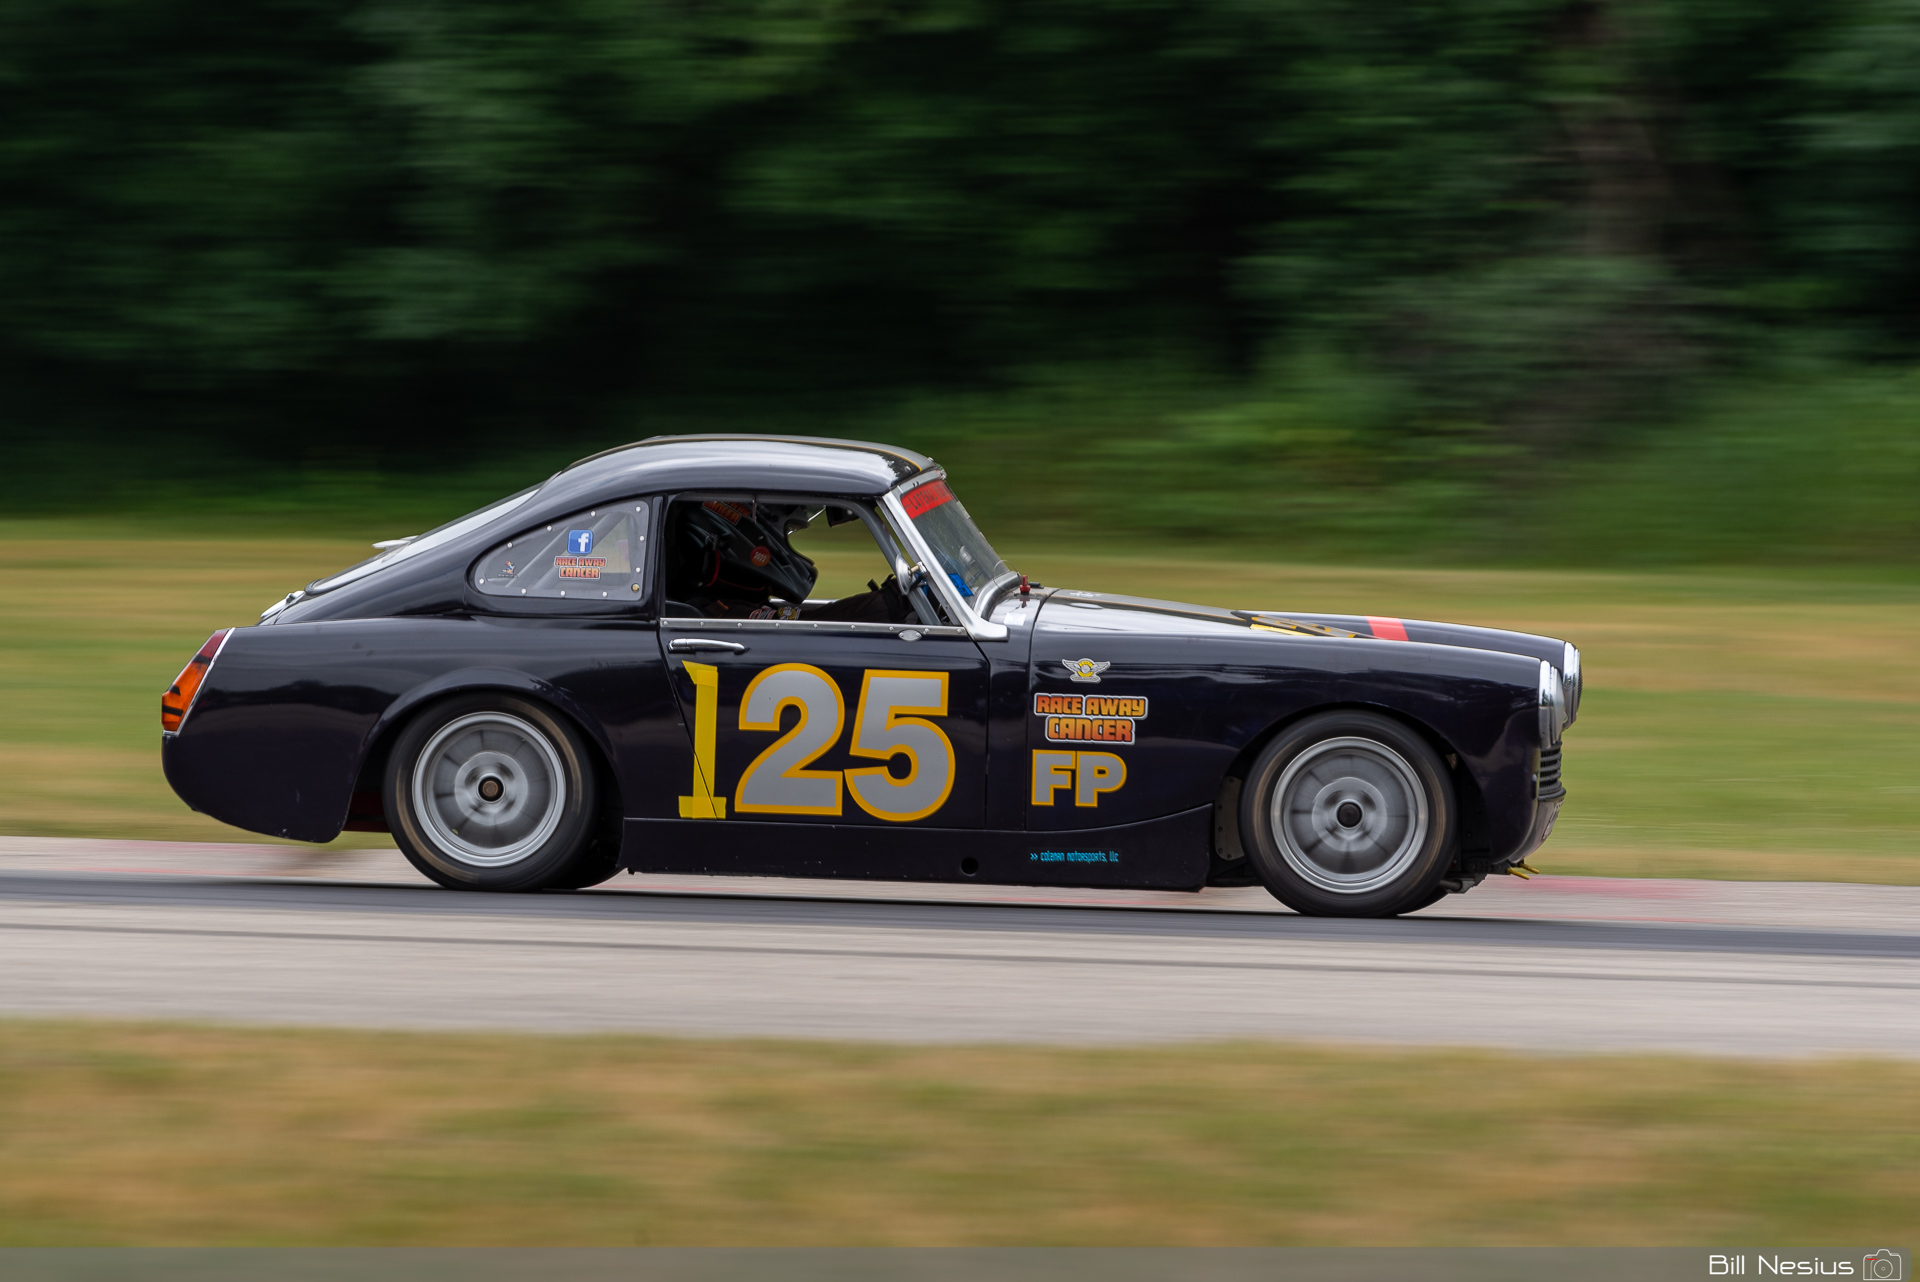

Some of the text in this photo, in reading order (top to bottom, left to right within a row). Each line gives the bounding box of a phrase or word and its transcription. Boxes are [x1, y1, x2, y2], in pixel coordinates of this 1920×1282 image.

[555, 557, 606, 567] RACE AWAY
[560, 567, 600, 578] CANCER
[1036, 695, 1145, 717] RACE AWAY
[678, 660, 956, 822] 125
[1047, 717, 1133, 742] CANCER
[1031, 749, 1128, 808] FP
